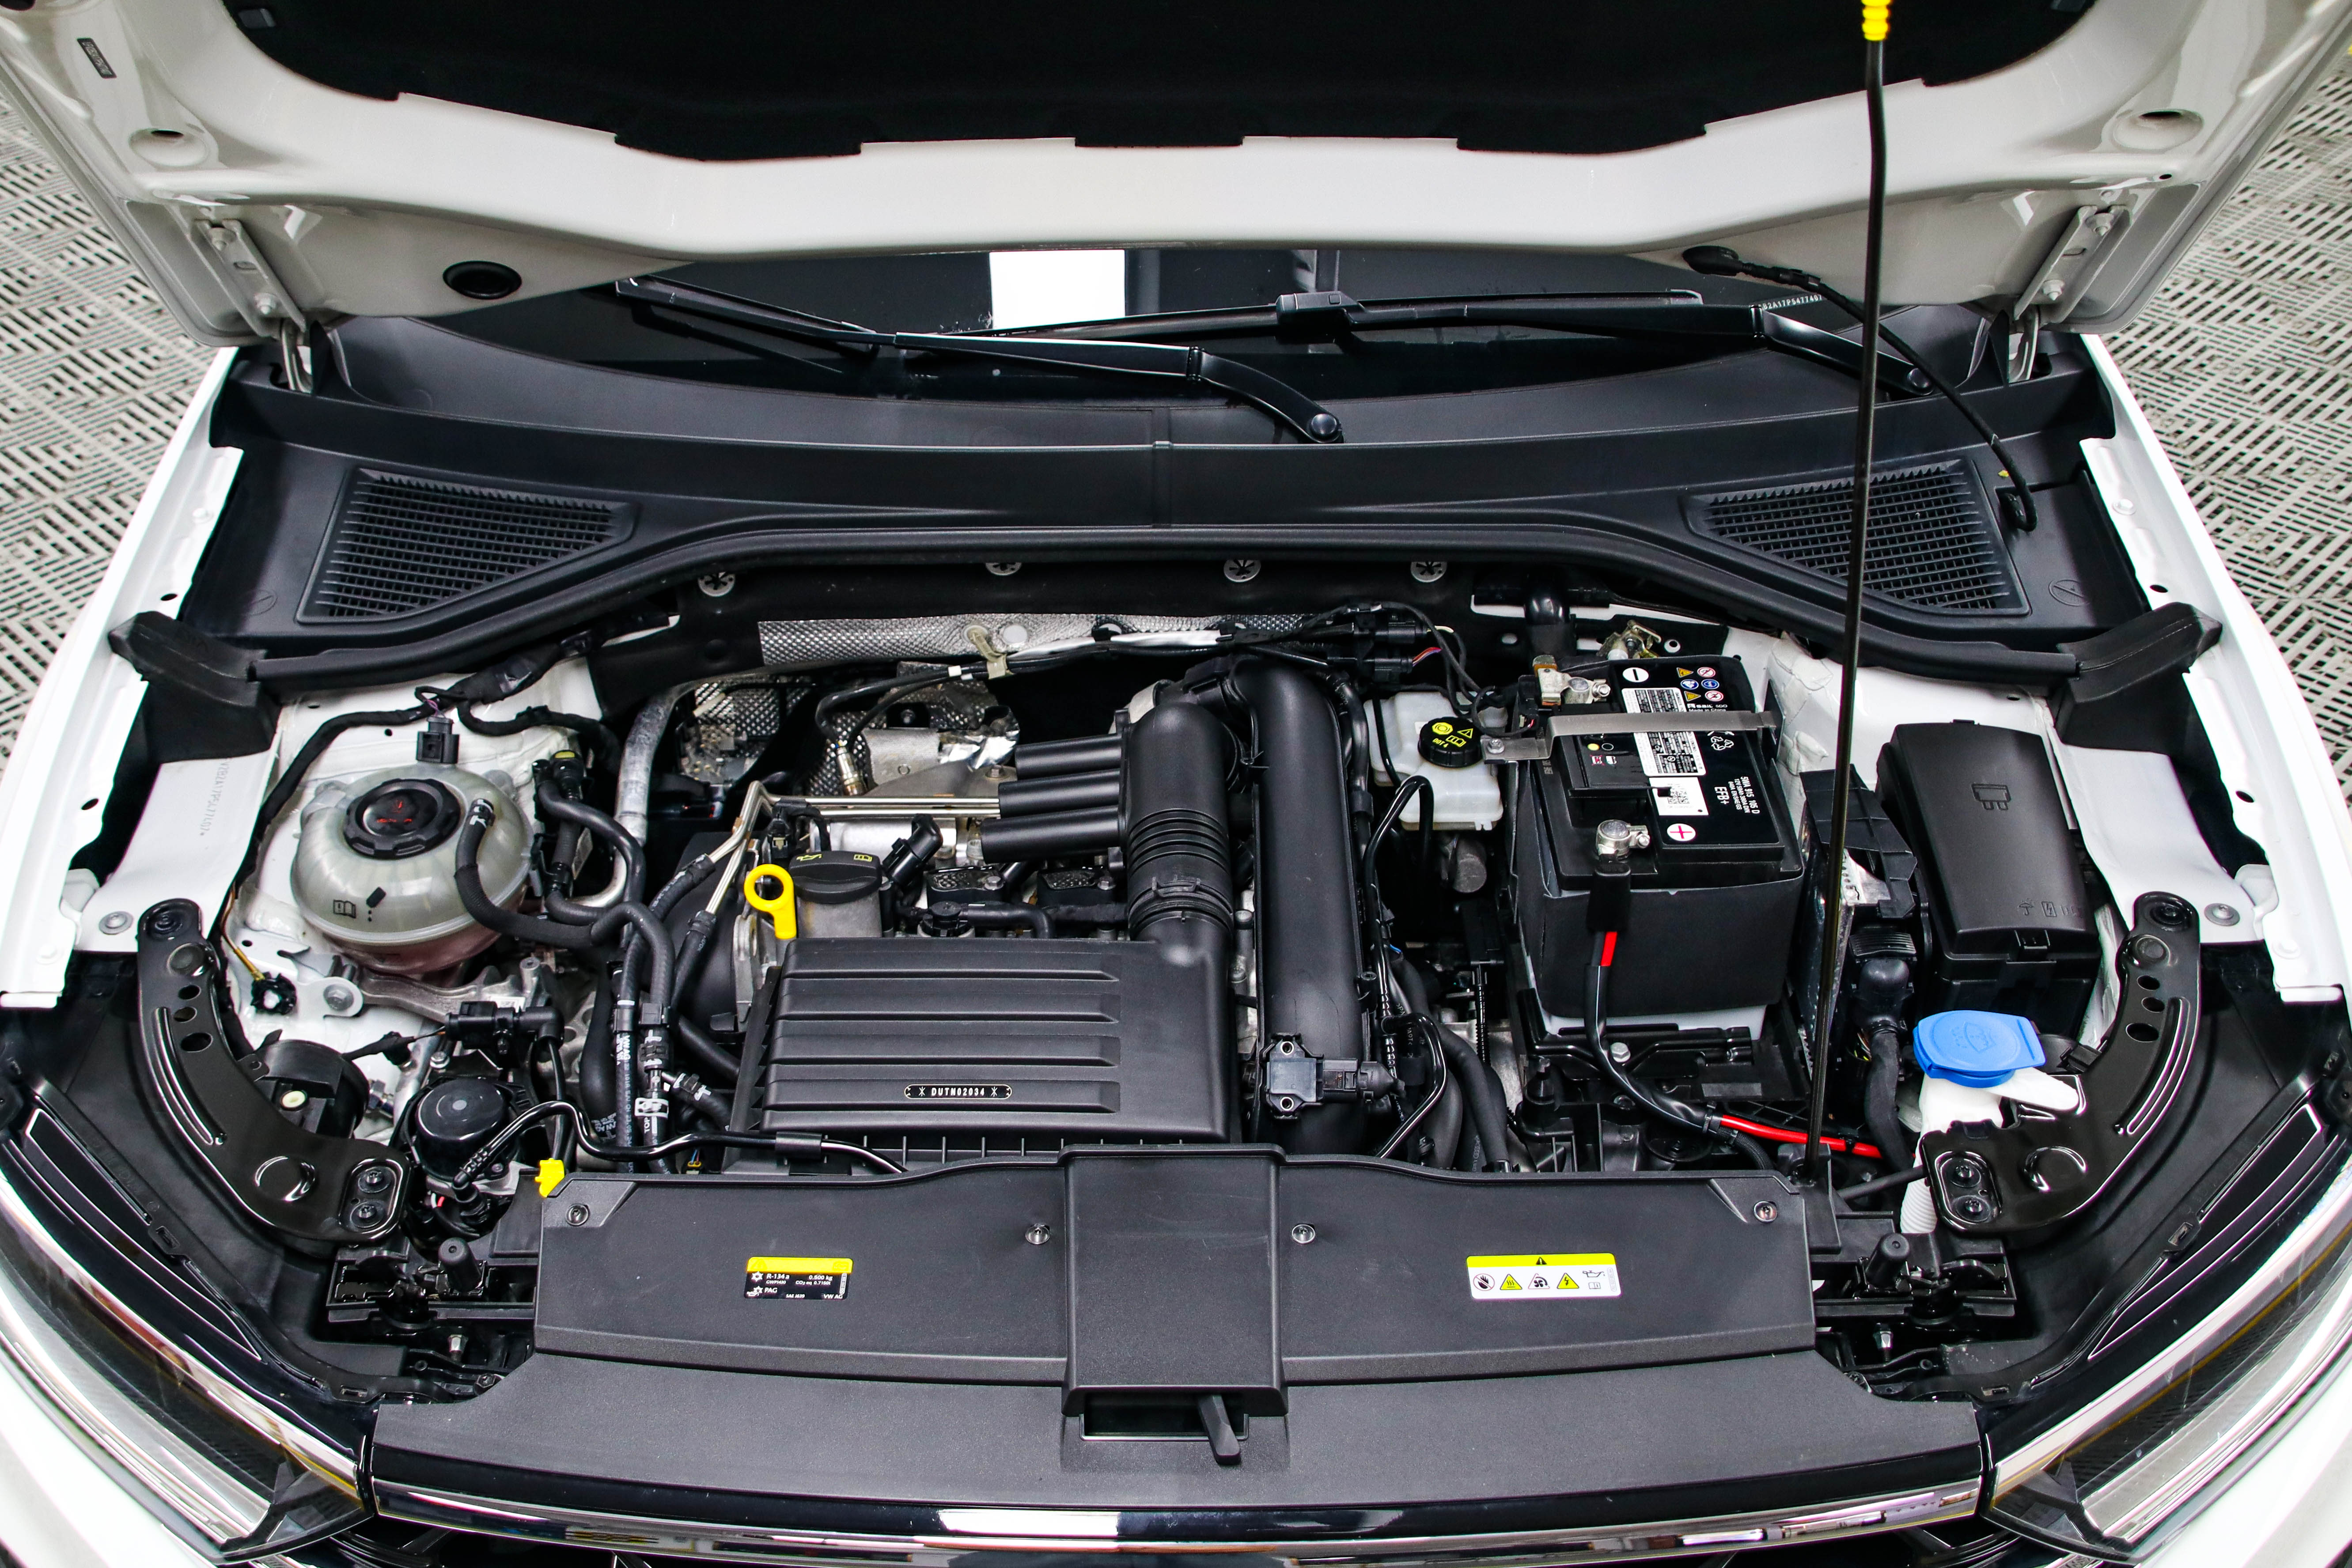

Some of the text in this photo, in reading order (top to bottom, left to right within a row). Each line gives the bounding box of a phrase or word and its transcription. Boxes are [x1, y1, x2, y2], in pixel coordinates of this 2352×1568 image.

[1740, 776, 1751, 788] 5WA
[1714, 787, 1729, 804] EFB+
[1744, 788, 1754, 797] 915
[1749, 800, 1758, 808] 105
